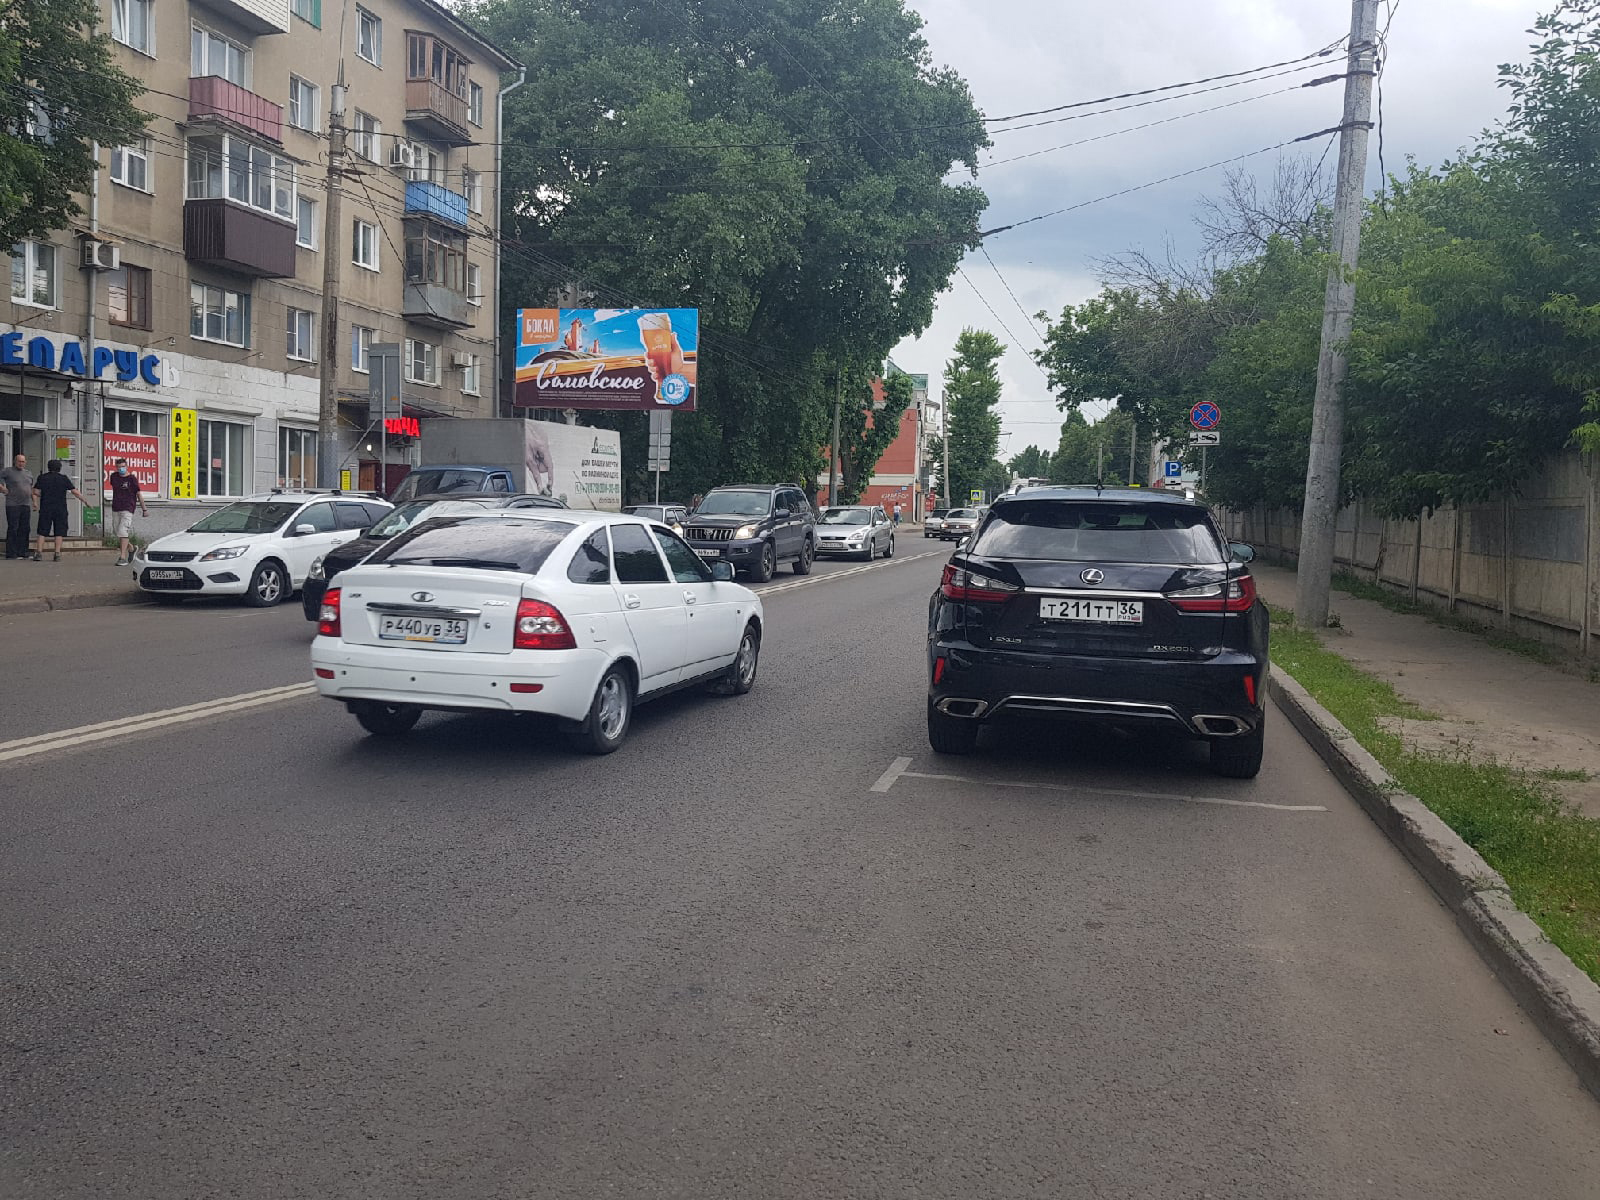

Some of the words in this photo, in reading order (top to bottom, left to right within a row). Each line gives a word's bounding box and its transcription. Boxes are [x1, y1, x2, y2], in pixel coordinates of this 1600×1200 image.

[526, 319, 555, 333] БОКАЛ
[142, 443, 156, 454] НА
[174, 412, 183, 497] АРЕНДА
[1047, 601, 1114, 618] Т211ТТ
[1120, 602, 1137, 615] 36
[385, 619, 442, 636] Р440УВ
[446, 620, 461, 634] 36
